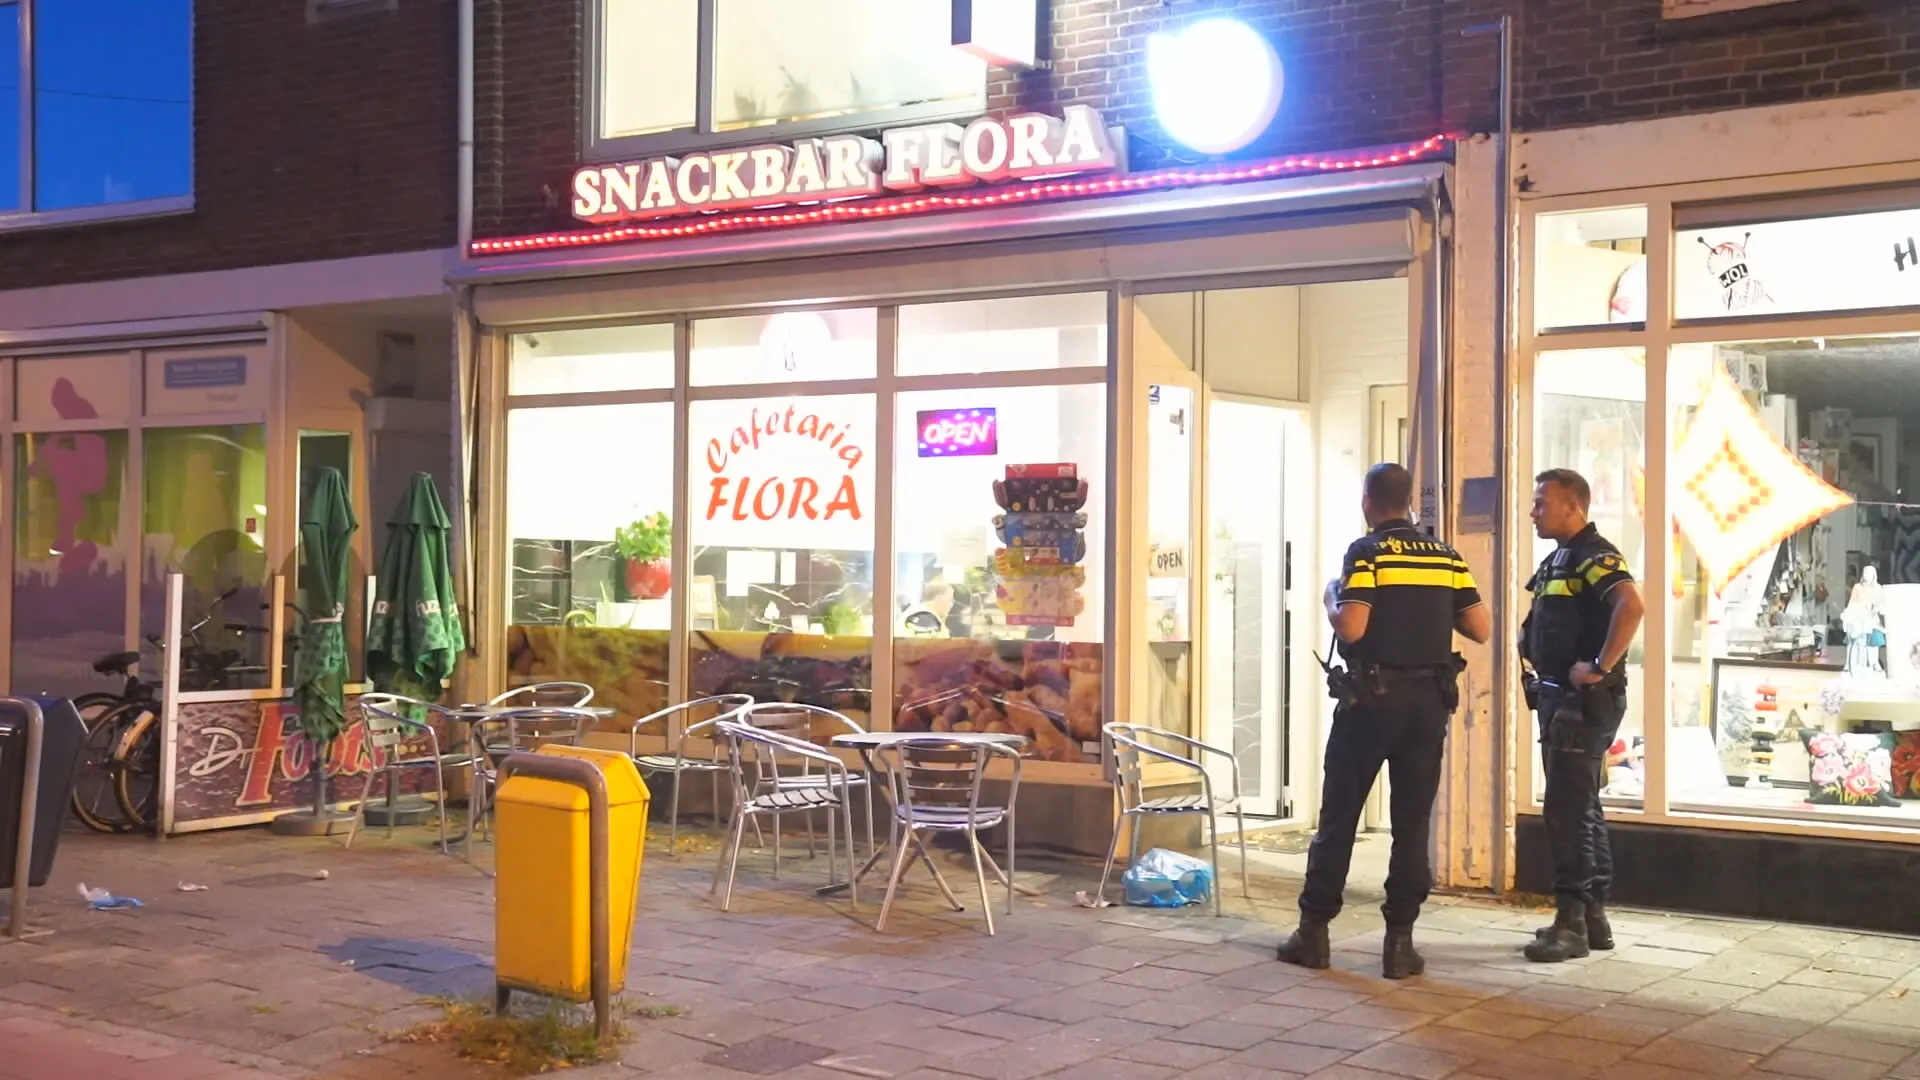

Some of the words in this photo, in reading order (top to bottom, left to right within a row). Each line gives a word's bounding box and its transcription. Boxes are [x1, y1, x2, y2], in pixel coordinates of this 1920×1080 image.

[572, 137, 867, 218] SNACKBAR
[886, 105, 1103, 182] FLORA
[1719, 263, 1749, 289] WOL
[706, 404, 864, 474] Cafetaria
[924, 420, 990, 446] OPEN
[705, 474, 862, 521] FLORA
[1379, 537, 1447, 554] POLITIE
[1157, 549, 1183, 572] OPEN
